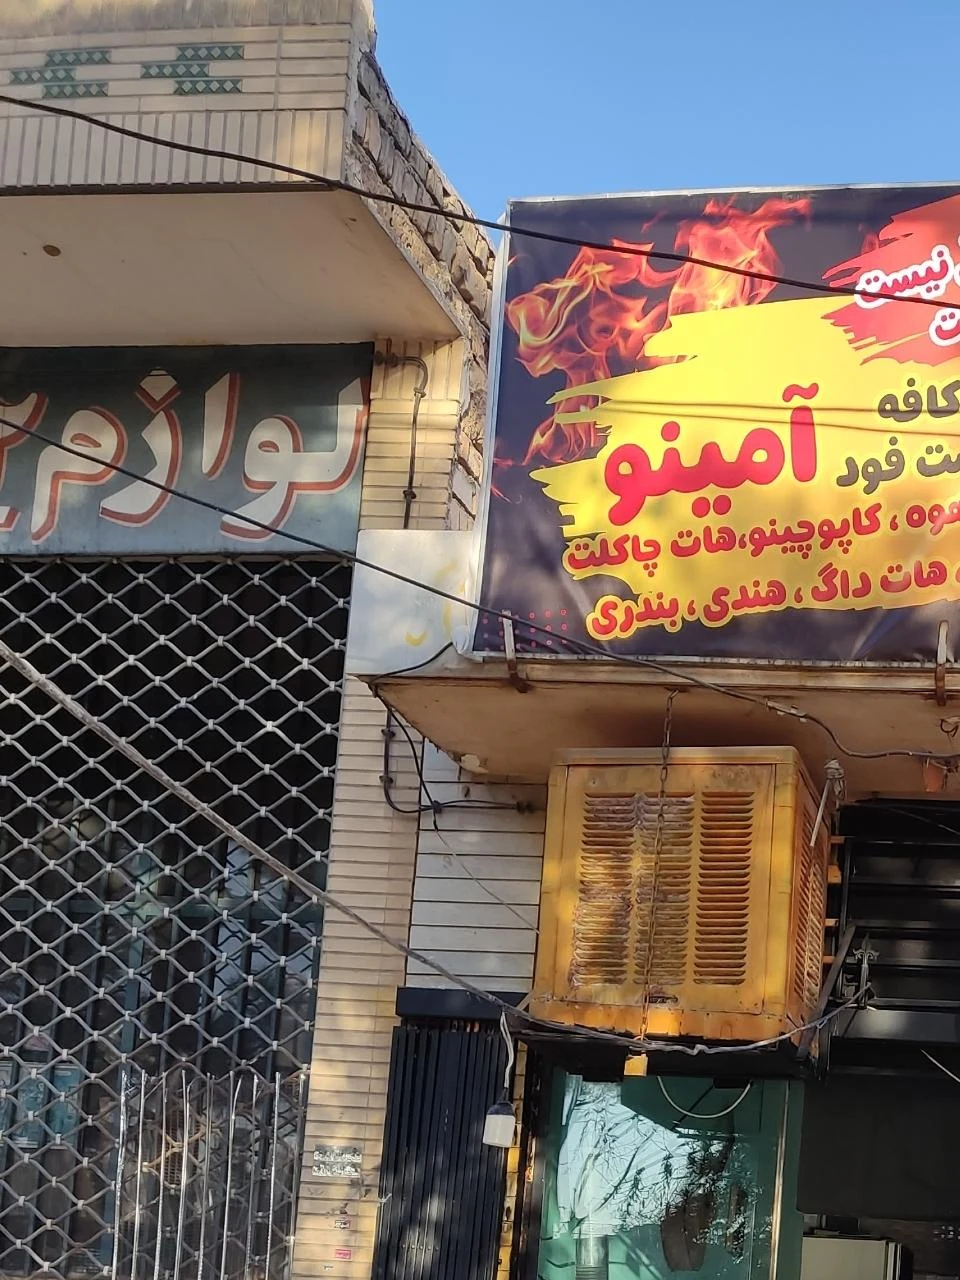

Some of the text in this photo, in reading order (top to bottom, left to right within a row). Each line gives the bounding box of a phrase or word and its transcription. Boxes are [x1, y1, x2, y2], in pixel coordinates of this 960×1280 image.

[859, 249, 950, 301] نیست
[30, 366, 370, 545] لوازم
[603, 382, 820, 527] آمینو
[836, 436, 906, 495] فود
[567, 534, 662, 577] چاکلت
[880, 560, 948, 593] هات
[591, 592, 679, 636] بندری
